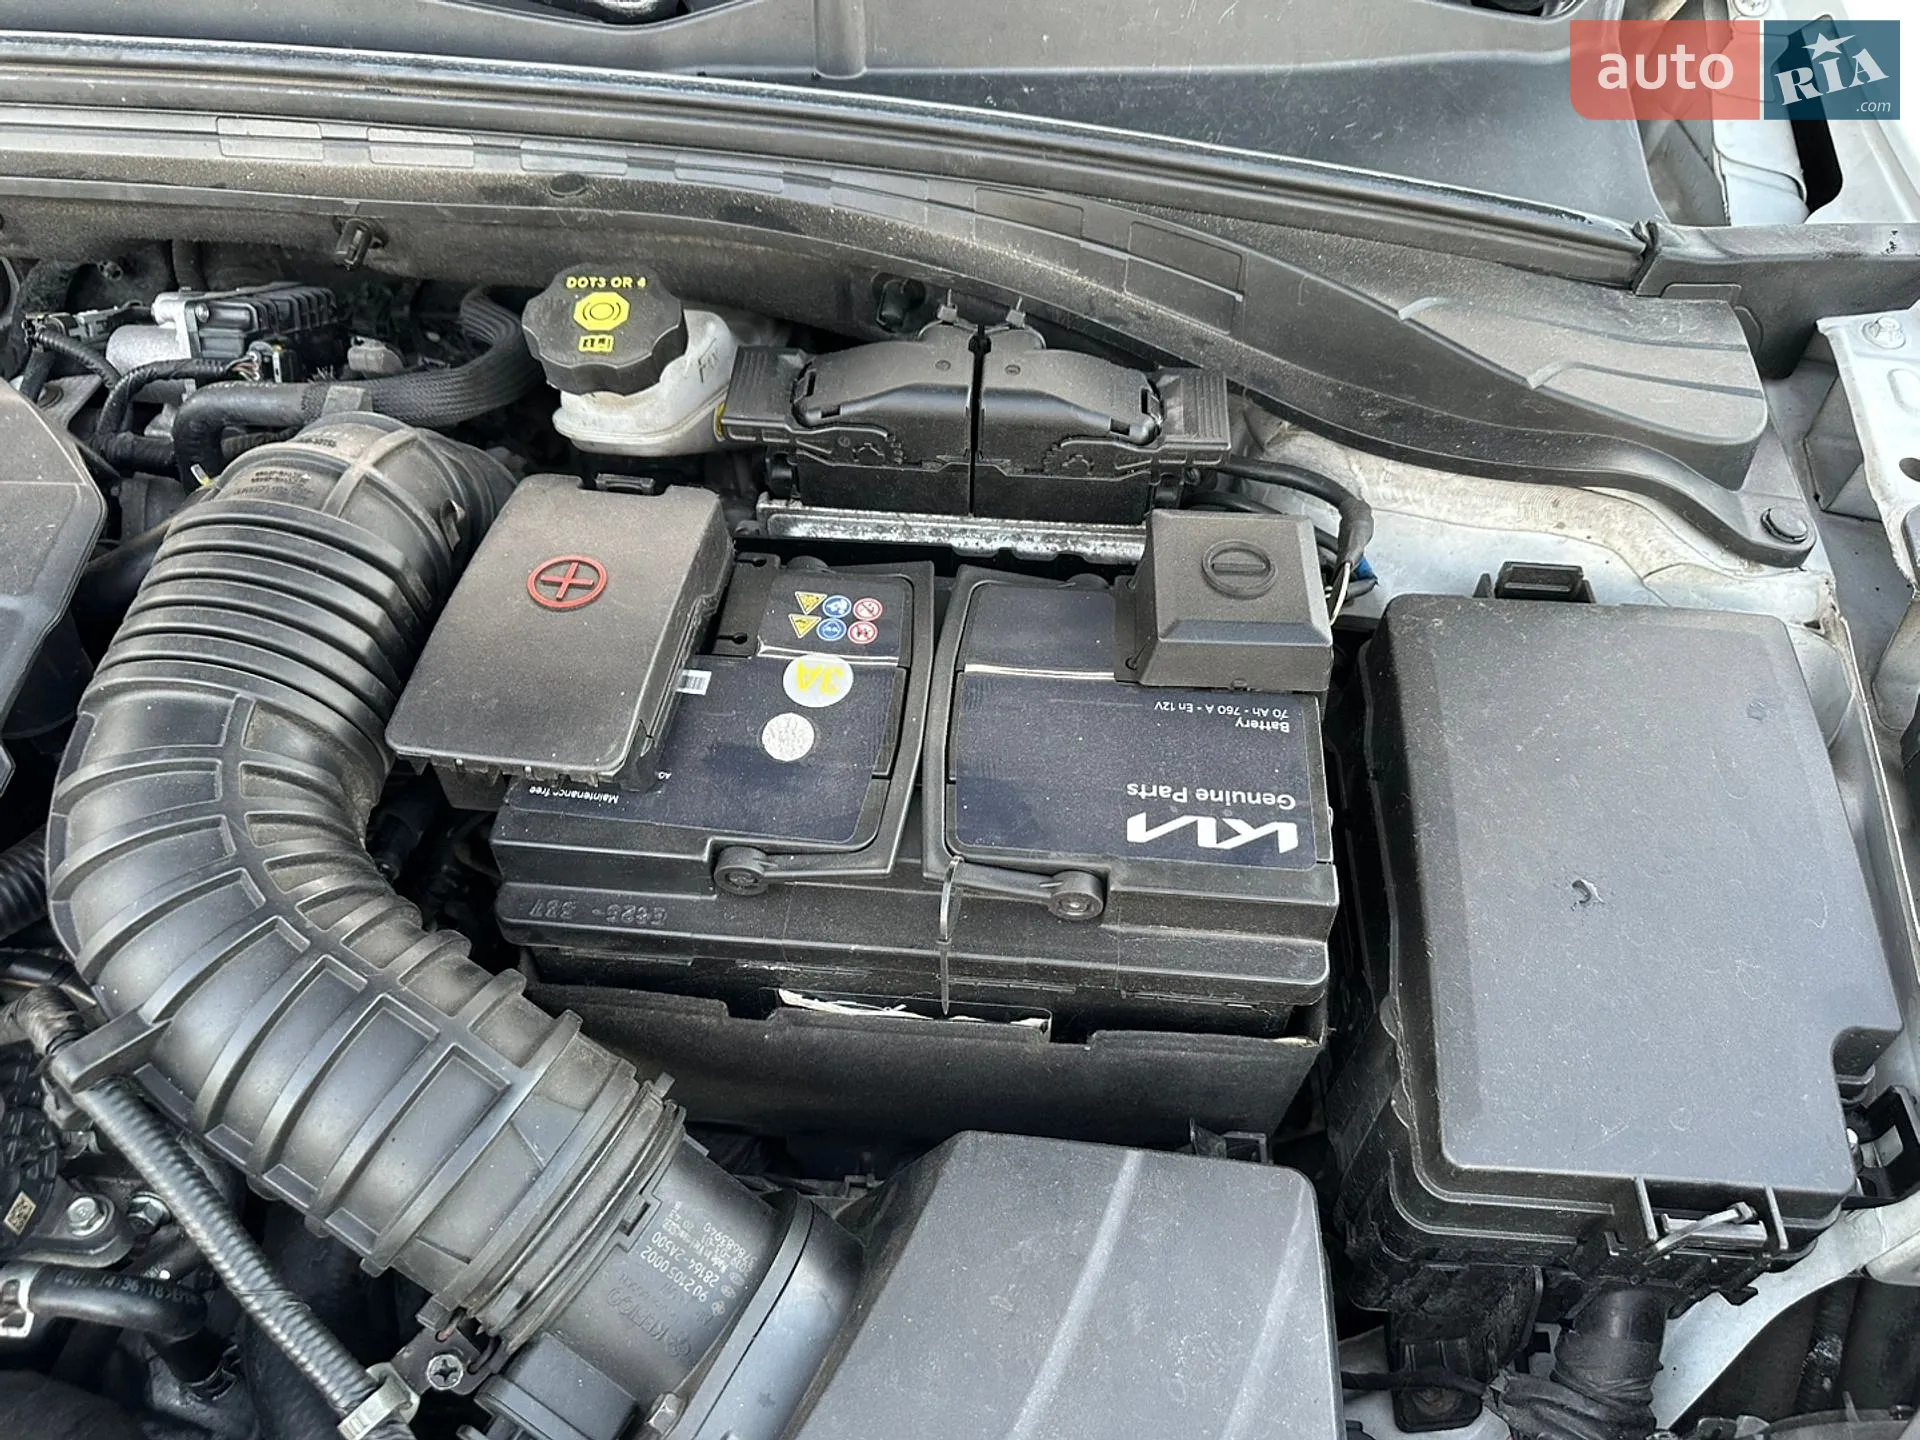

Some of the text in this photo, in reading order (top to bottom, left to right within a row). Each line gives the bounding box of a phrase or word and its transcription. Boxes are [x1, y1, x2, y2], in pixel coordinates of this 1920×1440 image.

[566, 276, 647, 289] DOT3 OR 4
[1154, 701, 1175, 711] 12V
[1179, 702, 1193, 713] En
[1205, 704, 1213, 714] A
[1253, 707, 1268, 717] Ah
[1272, 709, 1288, 719] 70
[1235, 717, 1290, 733] Battery
[529, 785, 552, 798] free
[1127, 783, 1296, 810] Genuine Parts
[1127, 812, 1298, 854] KIA
[640, 1245, 671, 1273] 0002
[650, 1231, 720, 1288] 28164-2A500
[666, 1266, 695, 1291] 2105
[692, 1284, 710, 1302] 90
